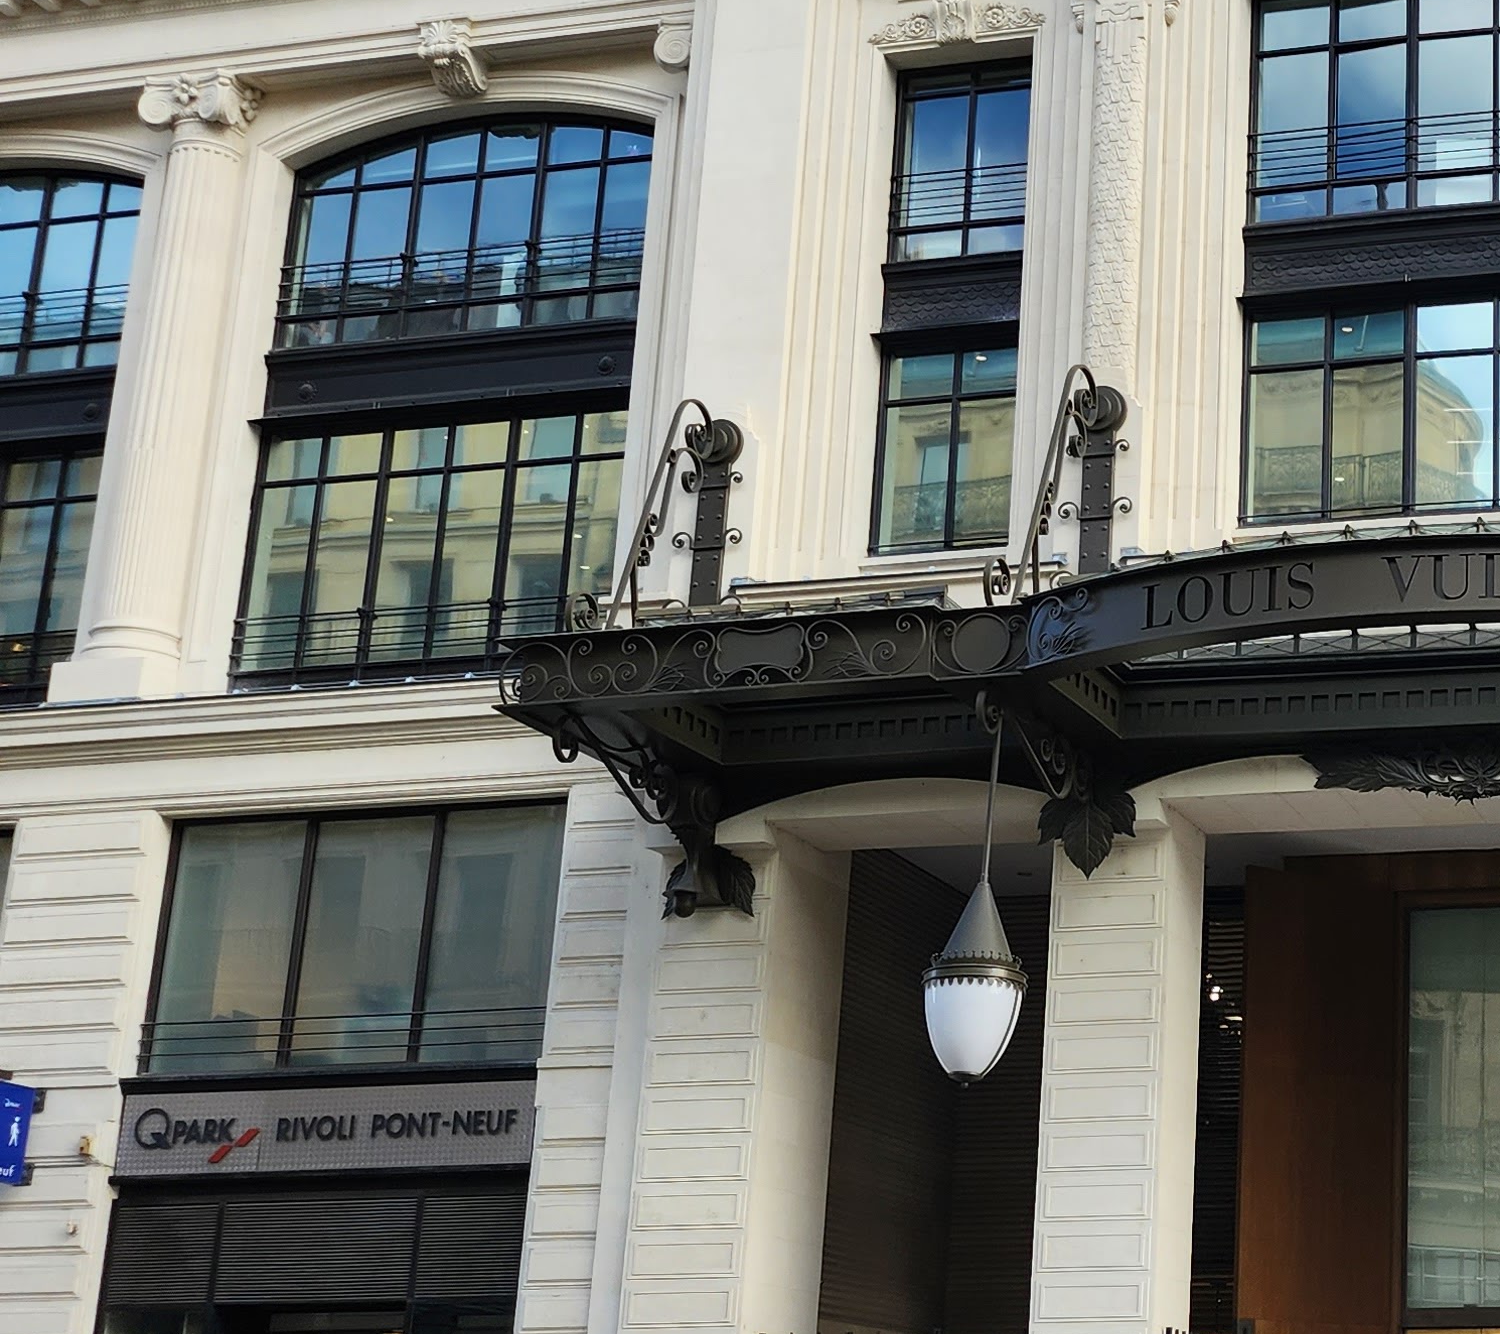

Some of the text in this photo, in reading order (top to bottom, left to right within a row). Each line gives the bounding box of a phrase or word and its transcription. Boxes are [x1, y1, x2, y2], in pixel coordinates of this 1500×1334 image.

[1140, 561, 1315, 631] LOUIS
[275, 1115, 356, 1142] RIVOLI
[370, 1109, 519, 1140] PONT-NEUF
